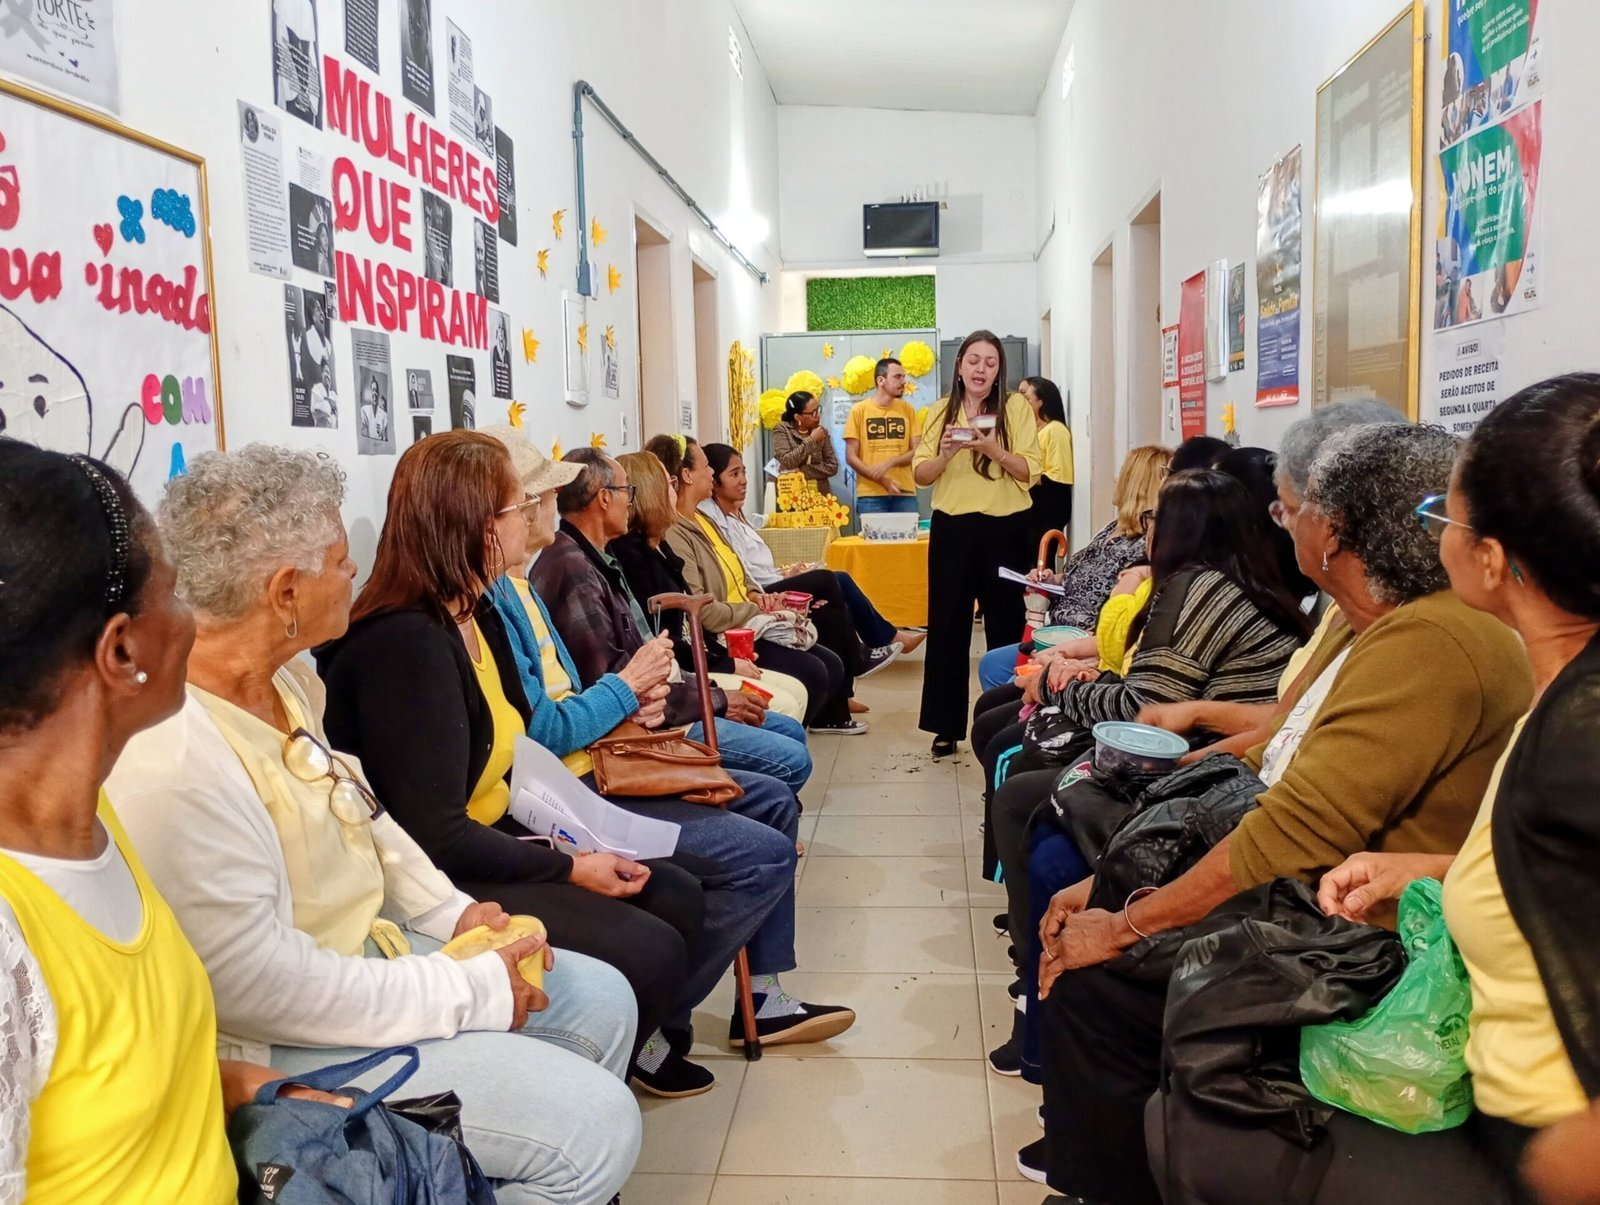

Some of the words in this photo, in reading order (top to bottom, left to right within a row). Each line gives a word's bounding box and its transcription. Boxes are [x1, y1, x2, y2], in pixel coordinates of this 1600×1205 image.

[323, 54, 501, 225] MULHERES
[332, 156, 412, 254] QUE
[336, 250, 490, 351] INSPIRAM
[1439, 368, 1463, 382] PEDIDOS
[1464, 366, 1473, 378] DE
[1473, 360, 1499, 376] RECEITA
[1440, 385, 1460, 399] SERÃO
[1460, 382, 1485, 396] ACEITOS
[1486, 380, 1495, 392] DE
[141, 373, 212, 426] COM
[1439, 403, 1466, 417] SEGUNDA
[1467, 403, 1472, 413] A
[868, 423, 885, 434] Ca
[888, 422, 905, 433] Fe
